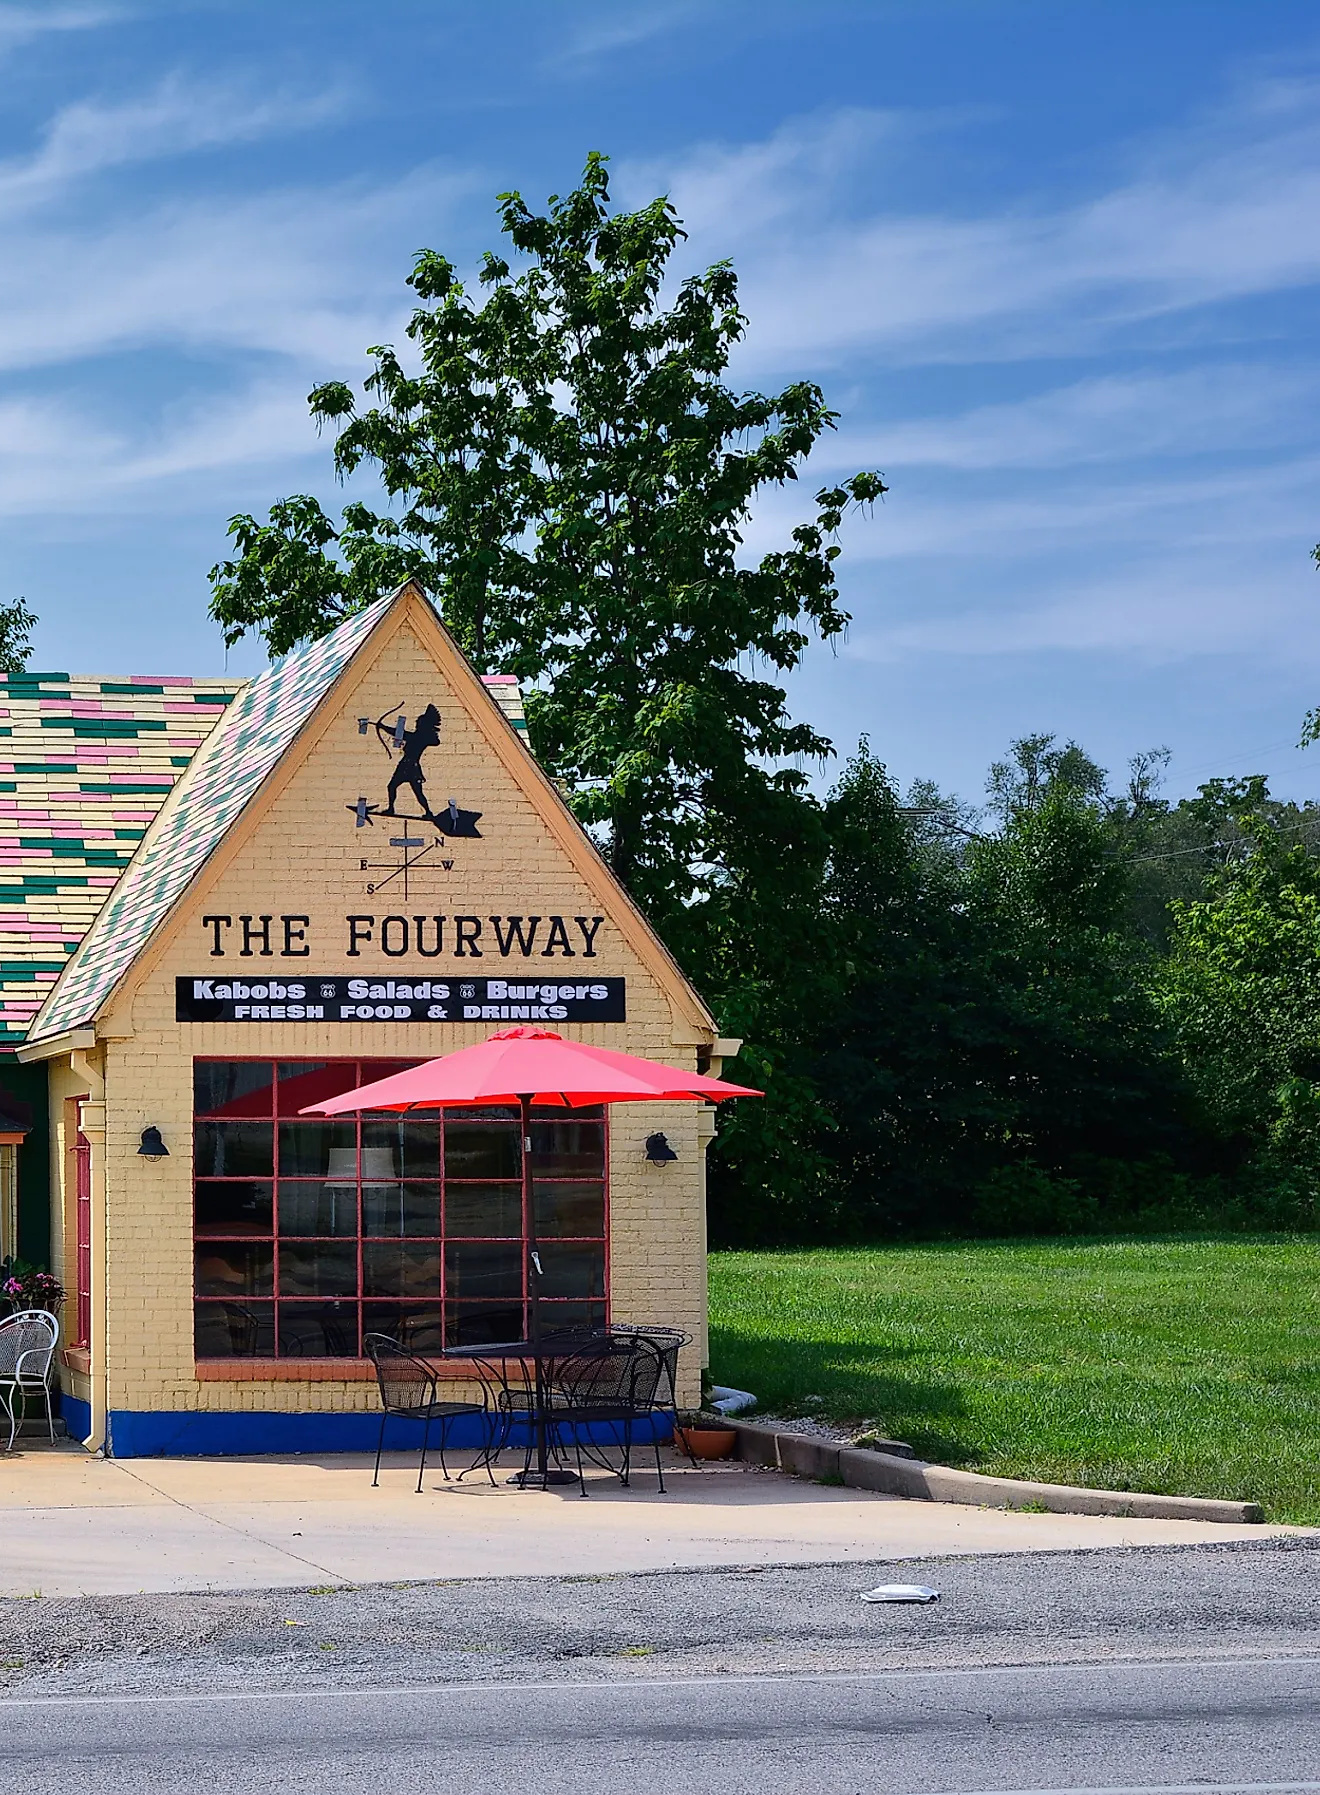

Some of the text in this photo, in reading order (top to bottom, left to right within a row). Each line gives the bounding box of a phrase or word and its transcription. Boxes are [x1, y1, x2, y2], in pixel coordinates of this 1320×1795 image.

[434, 837, 445, 848] N
[360, 860, 454, 870] E W
[367, 884, 375, 894] S
[203, 915, 605, 957] THE FOURWAY
[194, 981, 306, 999] Kabobs
[348, 980, 450, 999] Salads
[487, 981, 608, 1003] Burgers
[235, 1005, 567, 1018] FRESH FOOD & DRINKS
